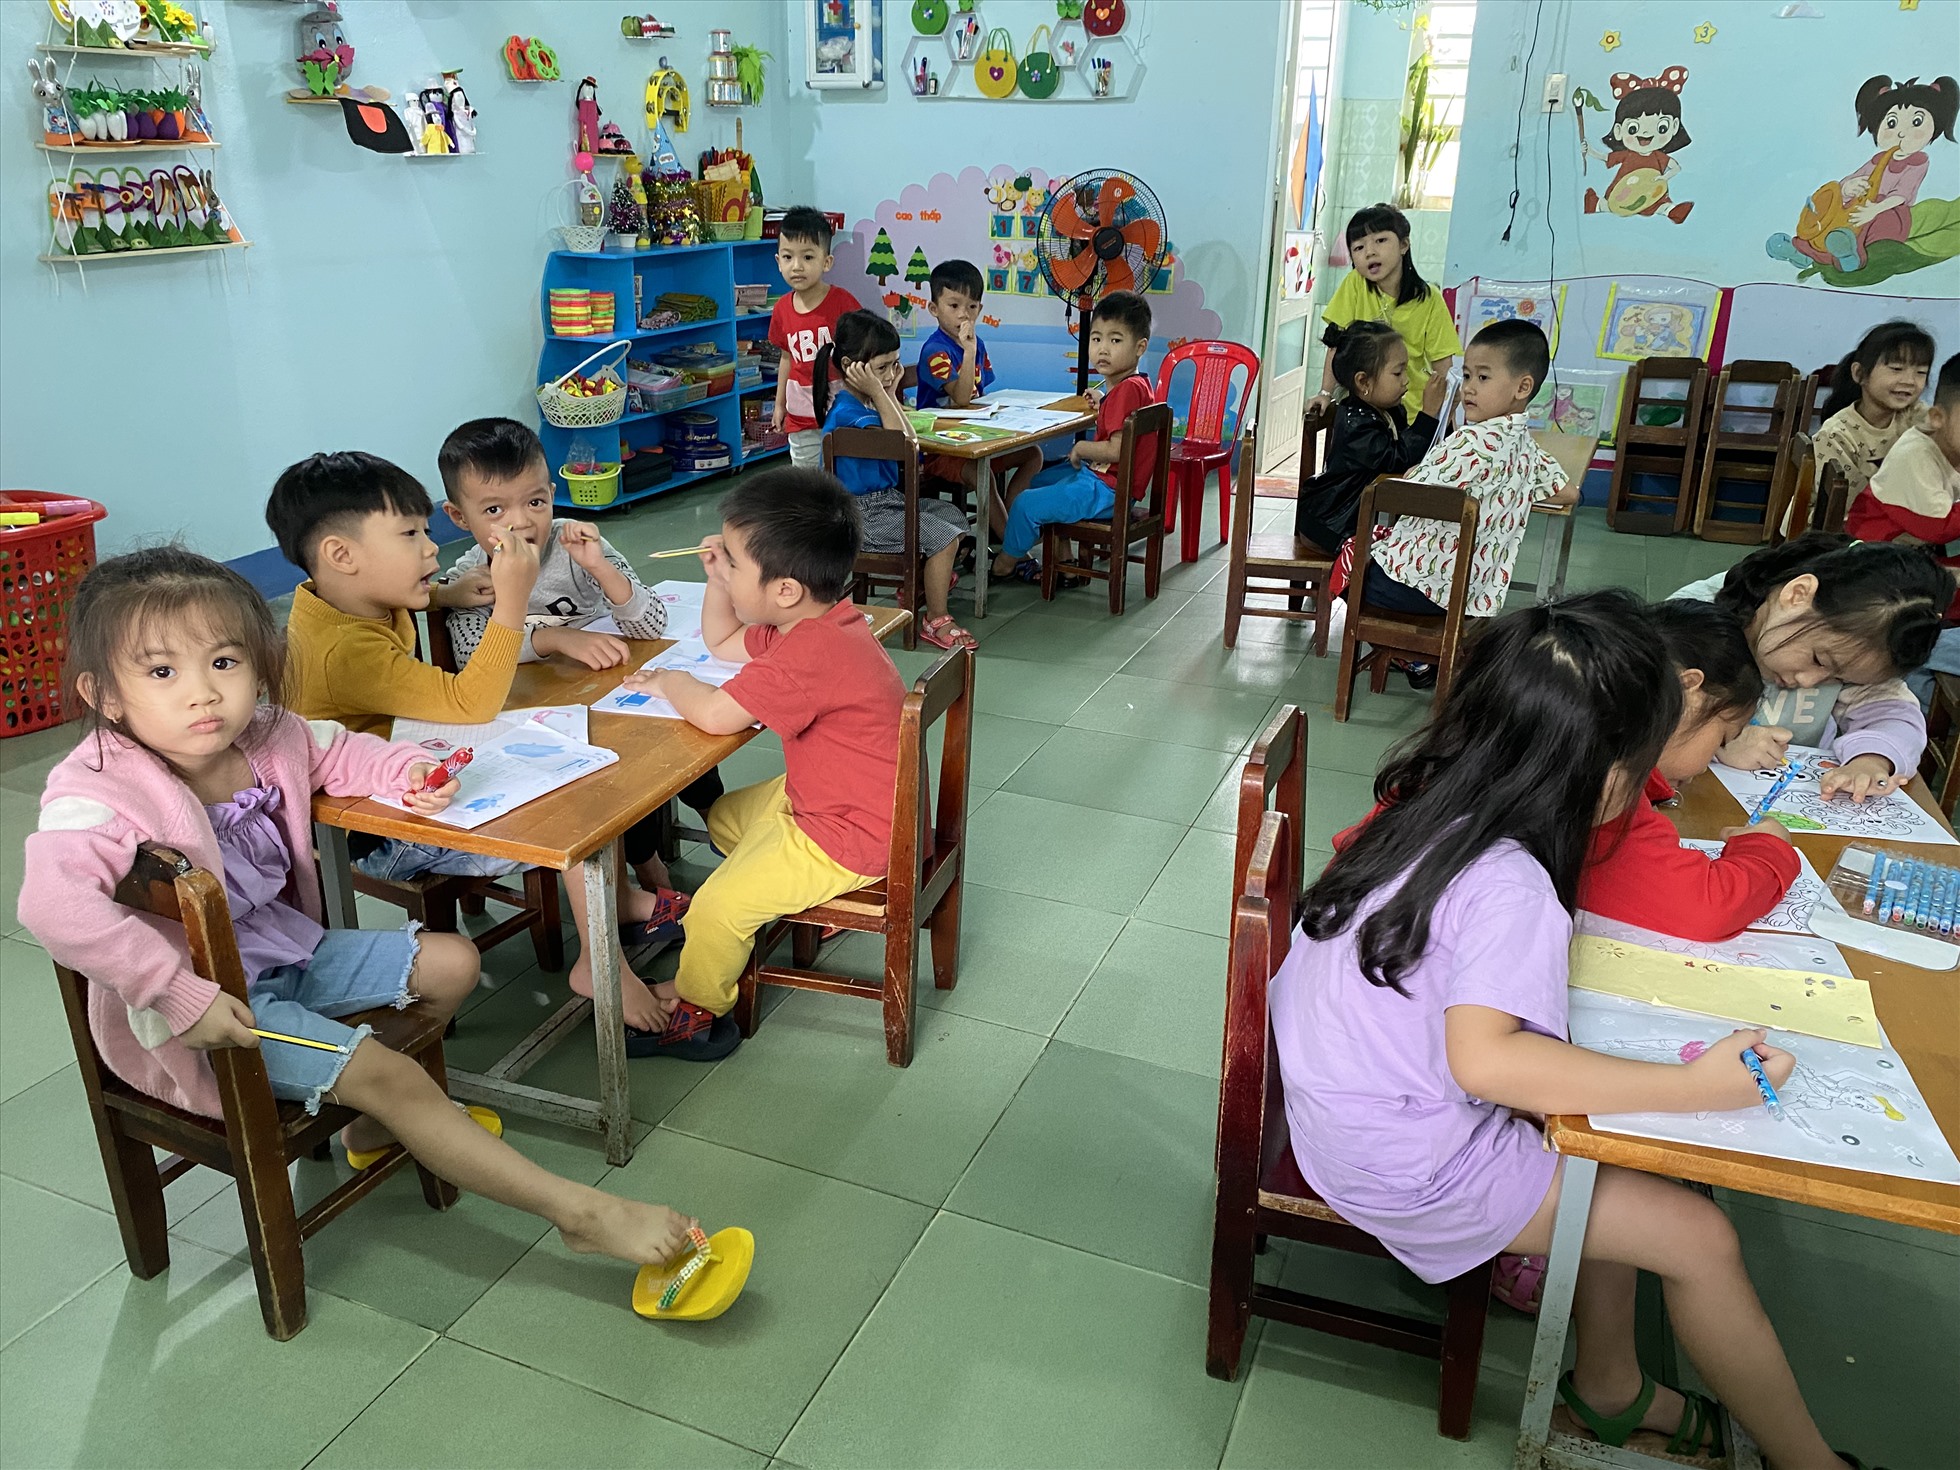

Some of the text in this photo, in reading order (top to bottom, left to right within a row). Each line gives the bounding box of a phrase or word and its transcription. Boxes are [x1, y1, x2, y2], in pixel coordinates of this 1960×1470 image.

[1700, 26, 1709, 38] 3
[895, 211, 913, 220] cao
[999, 219, 1036, 235] 1 2
[994, 274, 1032, 290] 6 7
